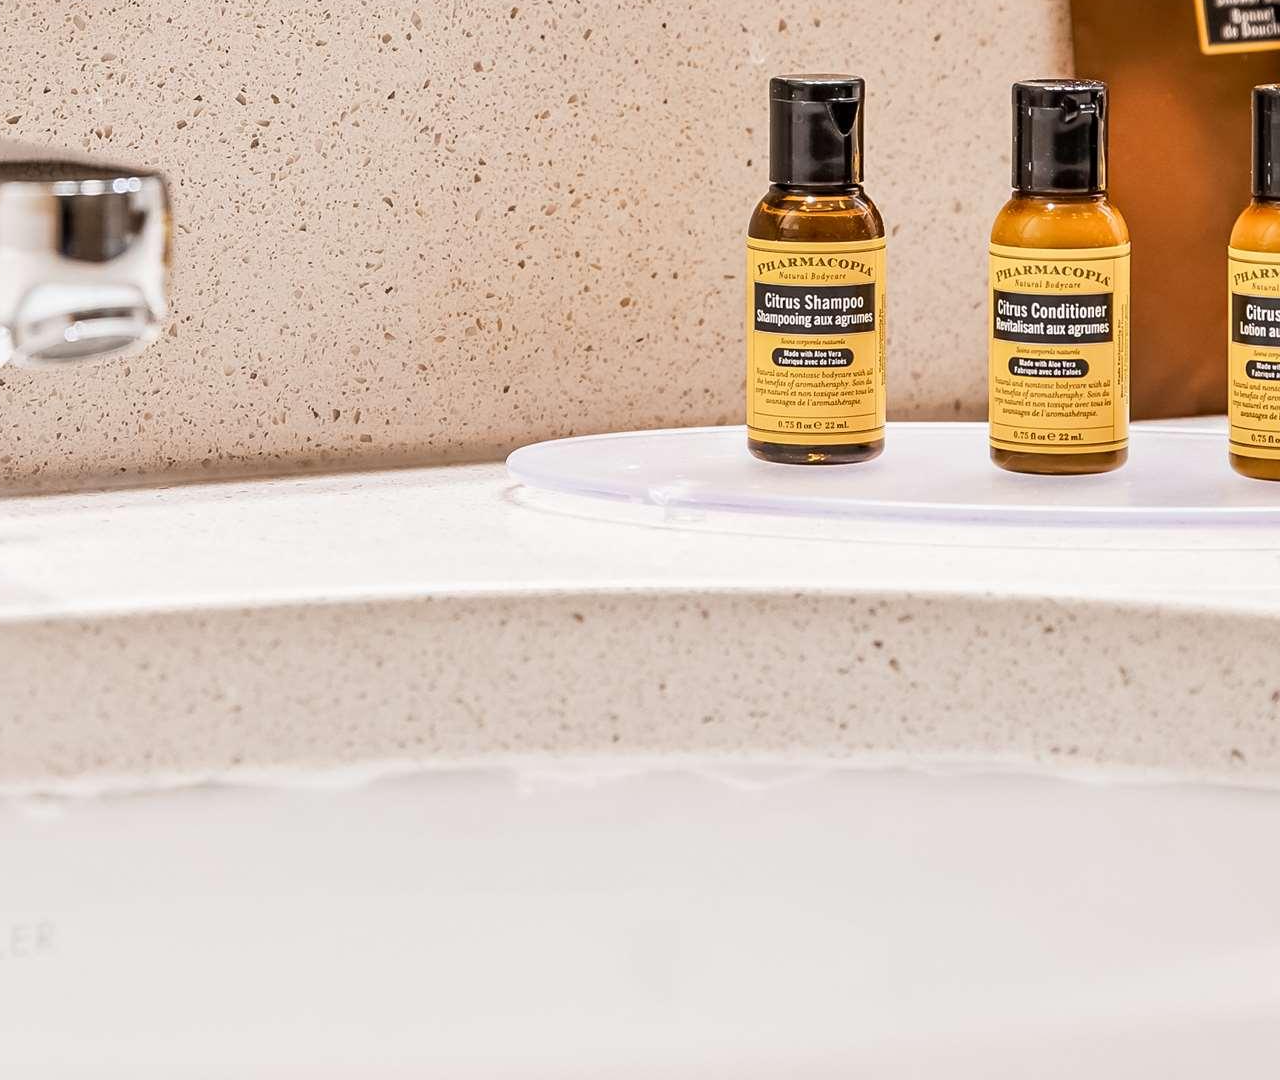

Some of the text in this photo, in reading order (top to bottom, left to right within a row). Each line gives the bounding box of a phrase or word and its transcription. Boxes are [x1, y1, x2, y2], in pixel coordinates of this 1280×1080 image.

[1231, 7, 1276, 24] Bonnet
[757, 257, 873, 277] PHARMACOPIA
[779, 272, 847, 282] Natural Bodycare
[996, 265, 1111, 287] PHARMACOPIA
[1015, 280, 1042, 288] Natural
[1252, 283, 1279, 292] Natural
[765, 292, 864, 312] Citrus Shampoo
[998, 299, 1107, 319] Citrus Conditioner
[757, 309, 873, 328] Shampooing aux agrumes
[996, 317, 1109, 338] Revitalisant aux agrumes
[1240, 321, 1266, 337] Lotion
[778, 421, 794, 429] 0.75
[825, 421, 835, 429] 22
[1014, 431, 1029, 439] 0.75
[1251, 434, 1266, 442] 0.75
